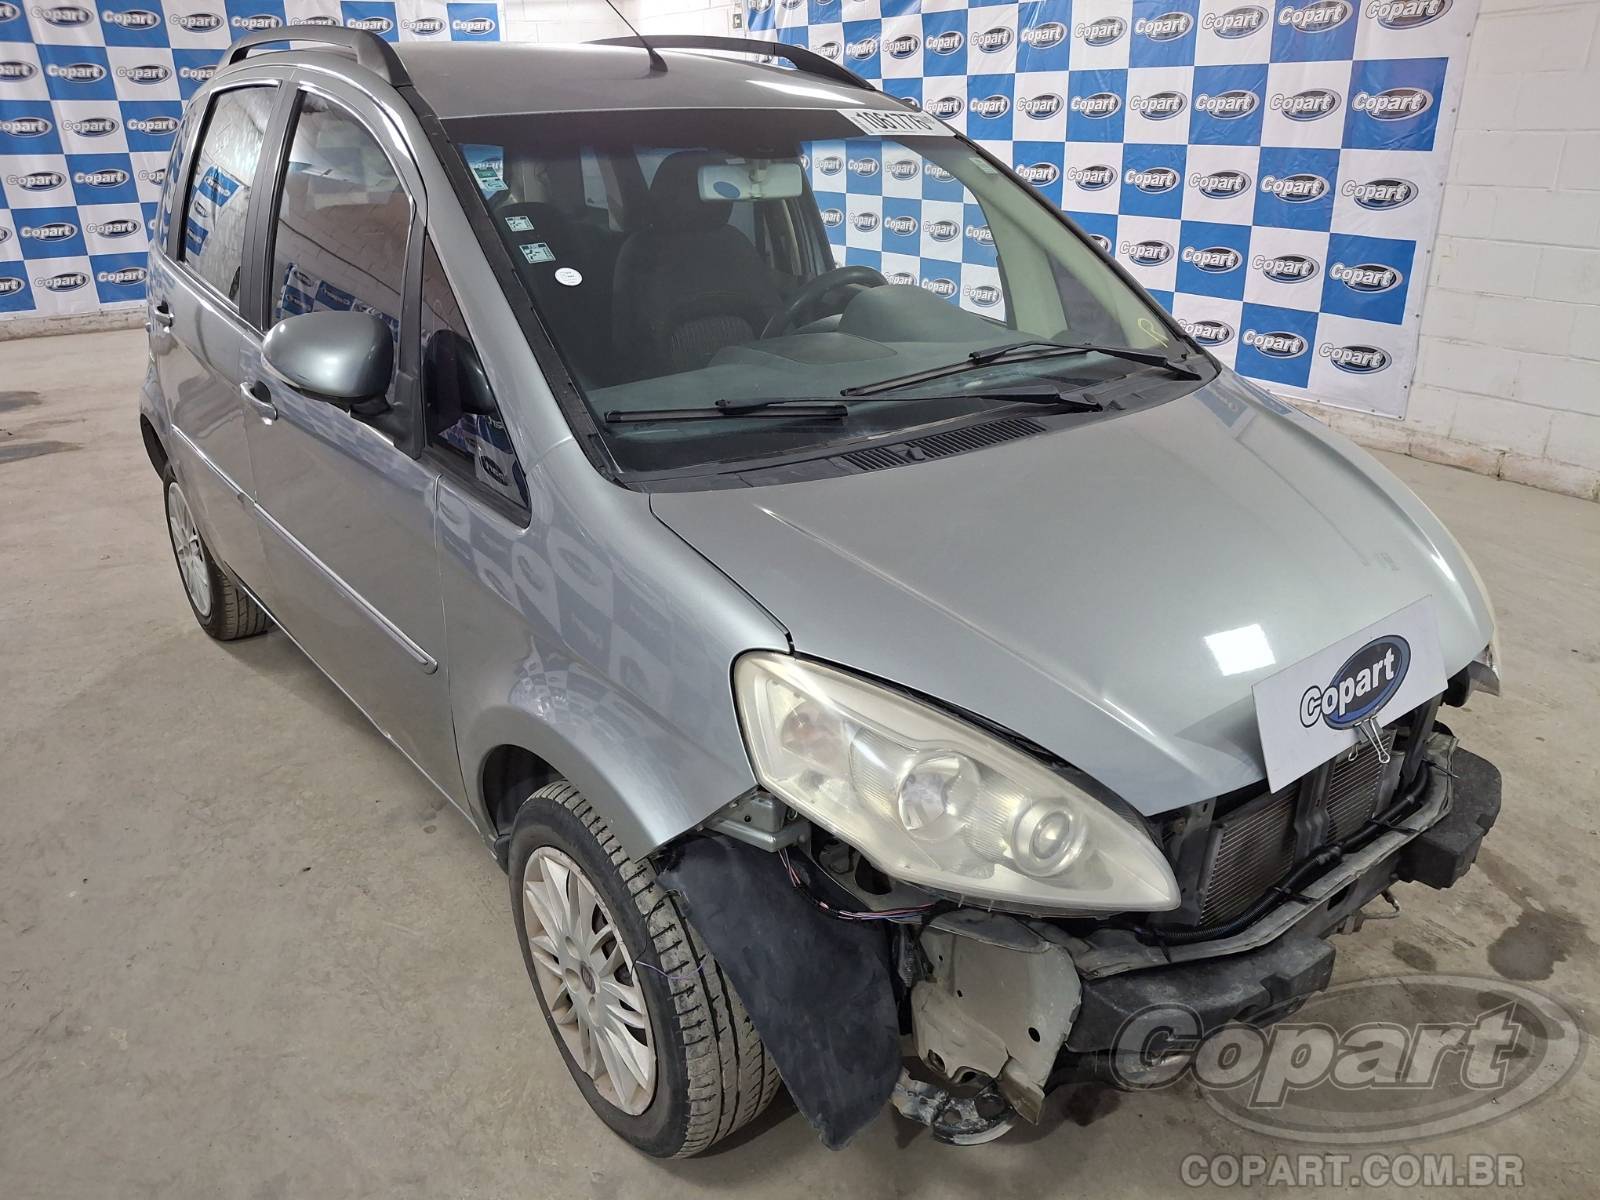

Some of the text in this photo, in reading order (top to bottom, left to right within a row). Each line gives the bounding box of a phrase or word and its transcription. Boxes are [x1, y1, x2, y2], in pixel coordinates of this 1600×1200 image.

[31, 6, 86, 22] Copart
[103, 10, 153, 26] Copart
[1278, 3, 1346, 28] Copart
[1365, 0, 1441, 22] Copart
[169, 14, 217, 27] Copart
[231, 16, 277, 28] Copart
[347, 18, 388, 30] Copart
[401, 19, 440, 32] Copart
[452, 19, 491, 32] Copart
[1135, 17, 1187, 37] Copart
[1202, 11, 1259, 33] Copart
[971, 31, 1008, 46] Copart
[1020, 27, 1062, 43] Copart
[1075, 21, 1121, 40] Copart
[882, 38, 915, 55] Copart
[926, 35, 959, 51] Copart
[47, 64, 101, 79] Copart
[116, 66, 166, 81] Copart
[180, 67, 215, 80] Copa
[926, 98, 959, 115] Copart
[970, 97, 1005, 115] Copart
[1016, 97, 1058, 114] Copart
[1071, 96, 1115, 114] Copart
[1130, 95, 1180, 114] Copart
[1195, 93, 1250, 114] Copart
[1269, 93, 1332, 115] Copart
[1352, 91, 1424, 115] Copart
[0, 120, 45, 134] opart
[62, 119, 113, 133] Copart
[127, 118, 175, 132] Copart
[815, 159, 840, 172] Copart
[848, 159, 876, 173] Copart
[885, 161, 915, 176] Copart
[1015, 164, 1054, 180] Copart
[6, 174, 60, 188] Copart
[74, 171, 124, 185] Copart
[1067, 167, 1112, 184] Copart
[1125, 169, 1174, 188] Copart
[1189, 173, 1244, 193] Copart
[1260, 175, 1321, 198] Copart
[1342, 180, 1408, 201] Copart
[820, 211, 841, 225] opart
[847, 211, 877, 227] Copart
[884, 216, 914, 231] Copart
[21, 225, 72, 240] Copart
[86, 221, 135, 236] Copart
[923, 221, 956, 236] Copart
[965, 225, 993, 240] Copa
[1120, 241, 1167, 259] Copart
[1182, 246, 1236, 267] Copart
[1252, 254, 1313, 275] Copart
[34, 273, 83, 289] Copart
[97, 269, 145, 283] Copart
[1329, 262, 1393, 287] Copart
[922, 277, 953, 293] Copart
[963, 284, 998, 301] Copart
[1242, 328, 1301, 354] Copart
[1319, 343, 1382, 368] Copart
[1300, 647, 1395, 728] Copart
